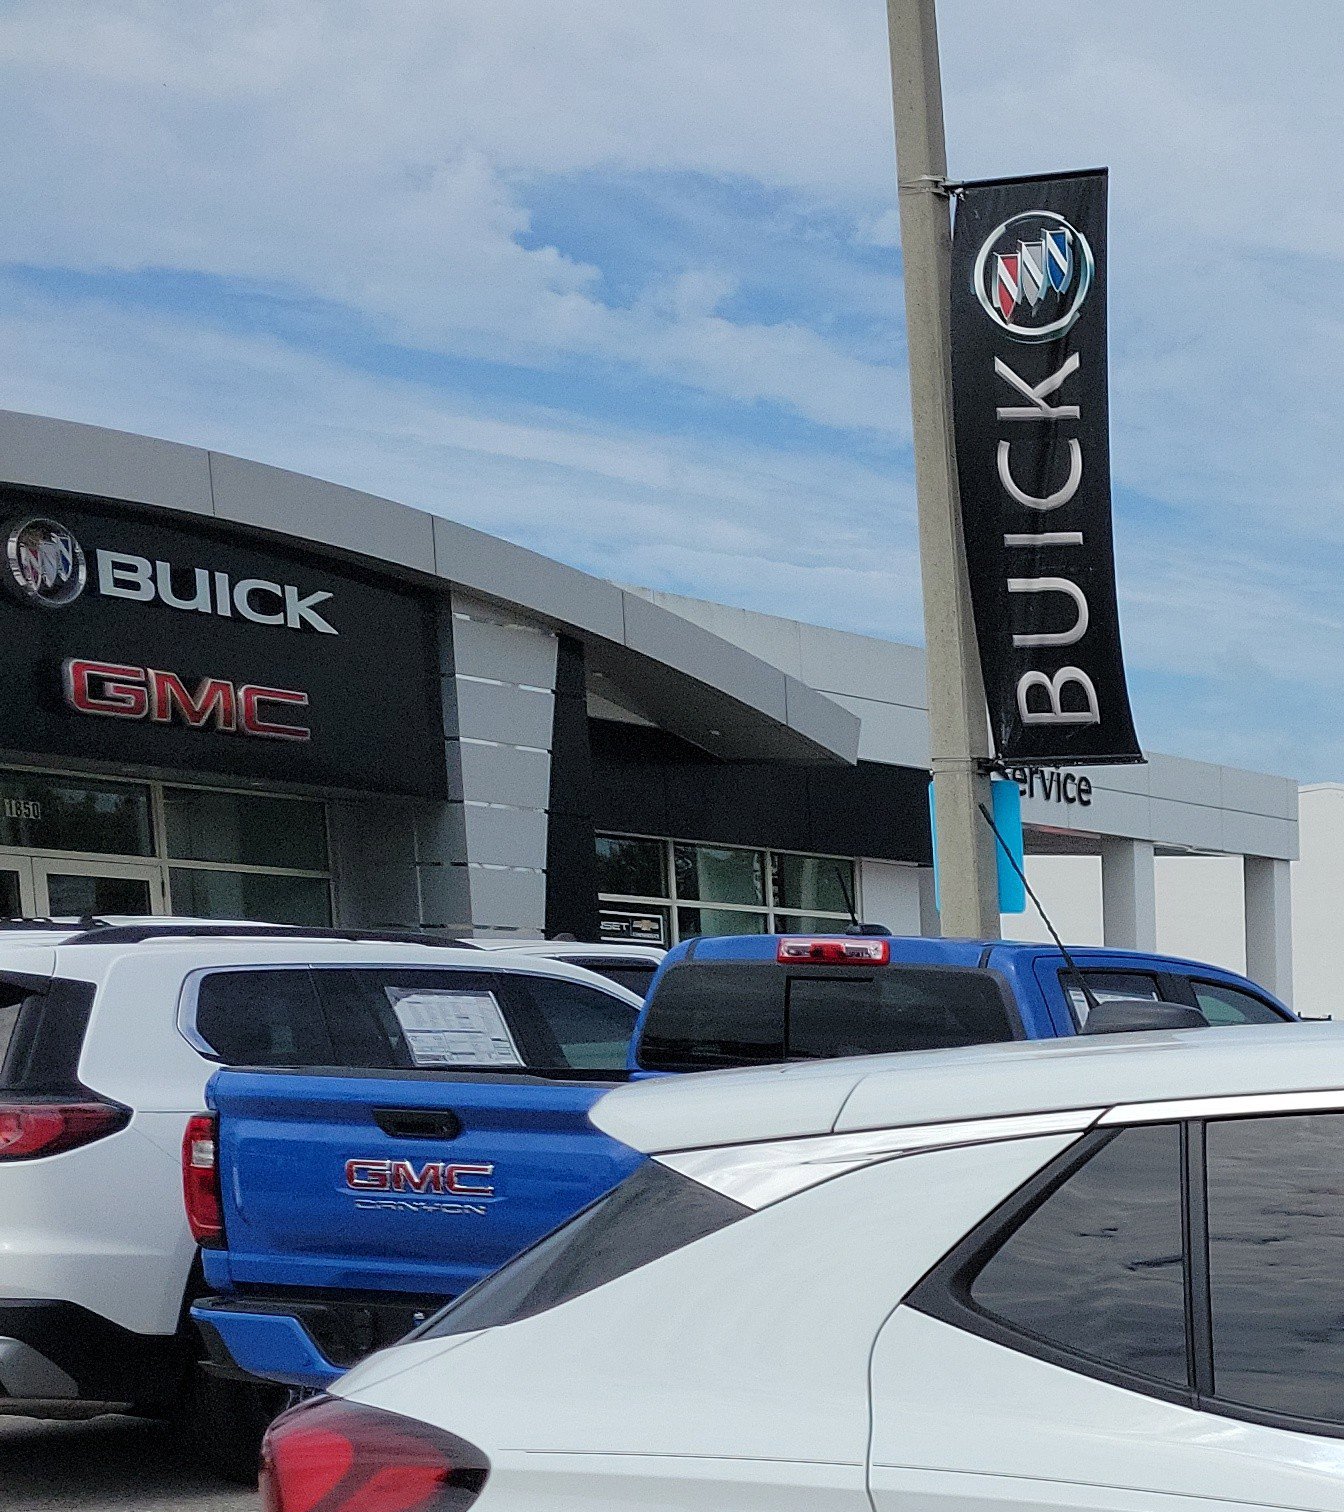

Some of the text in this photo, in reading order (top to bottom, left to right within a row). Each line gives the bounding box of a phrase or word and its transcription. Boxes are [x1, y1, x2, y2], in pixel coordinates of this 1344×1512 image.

[994, 351, 1101, 727] BUICK
[96, 548, 339, 636] BUICK
[66, 657, 311, 741] GMC
[1004, 767, 1093, 807] ervice
[345, 1158, 495, 1197] GMC
[354, 1199, 487, 1216] CANYON
